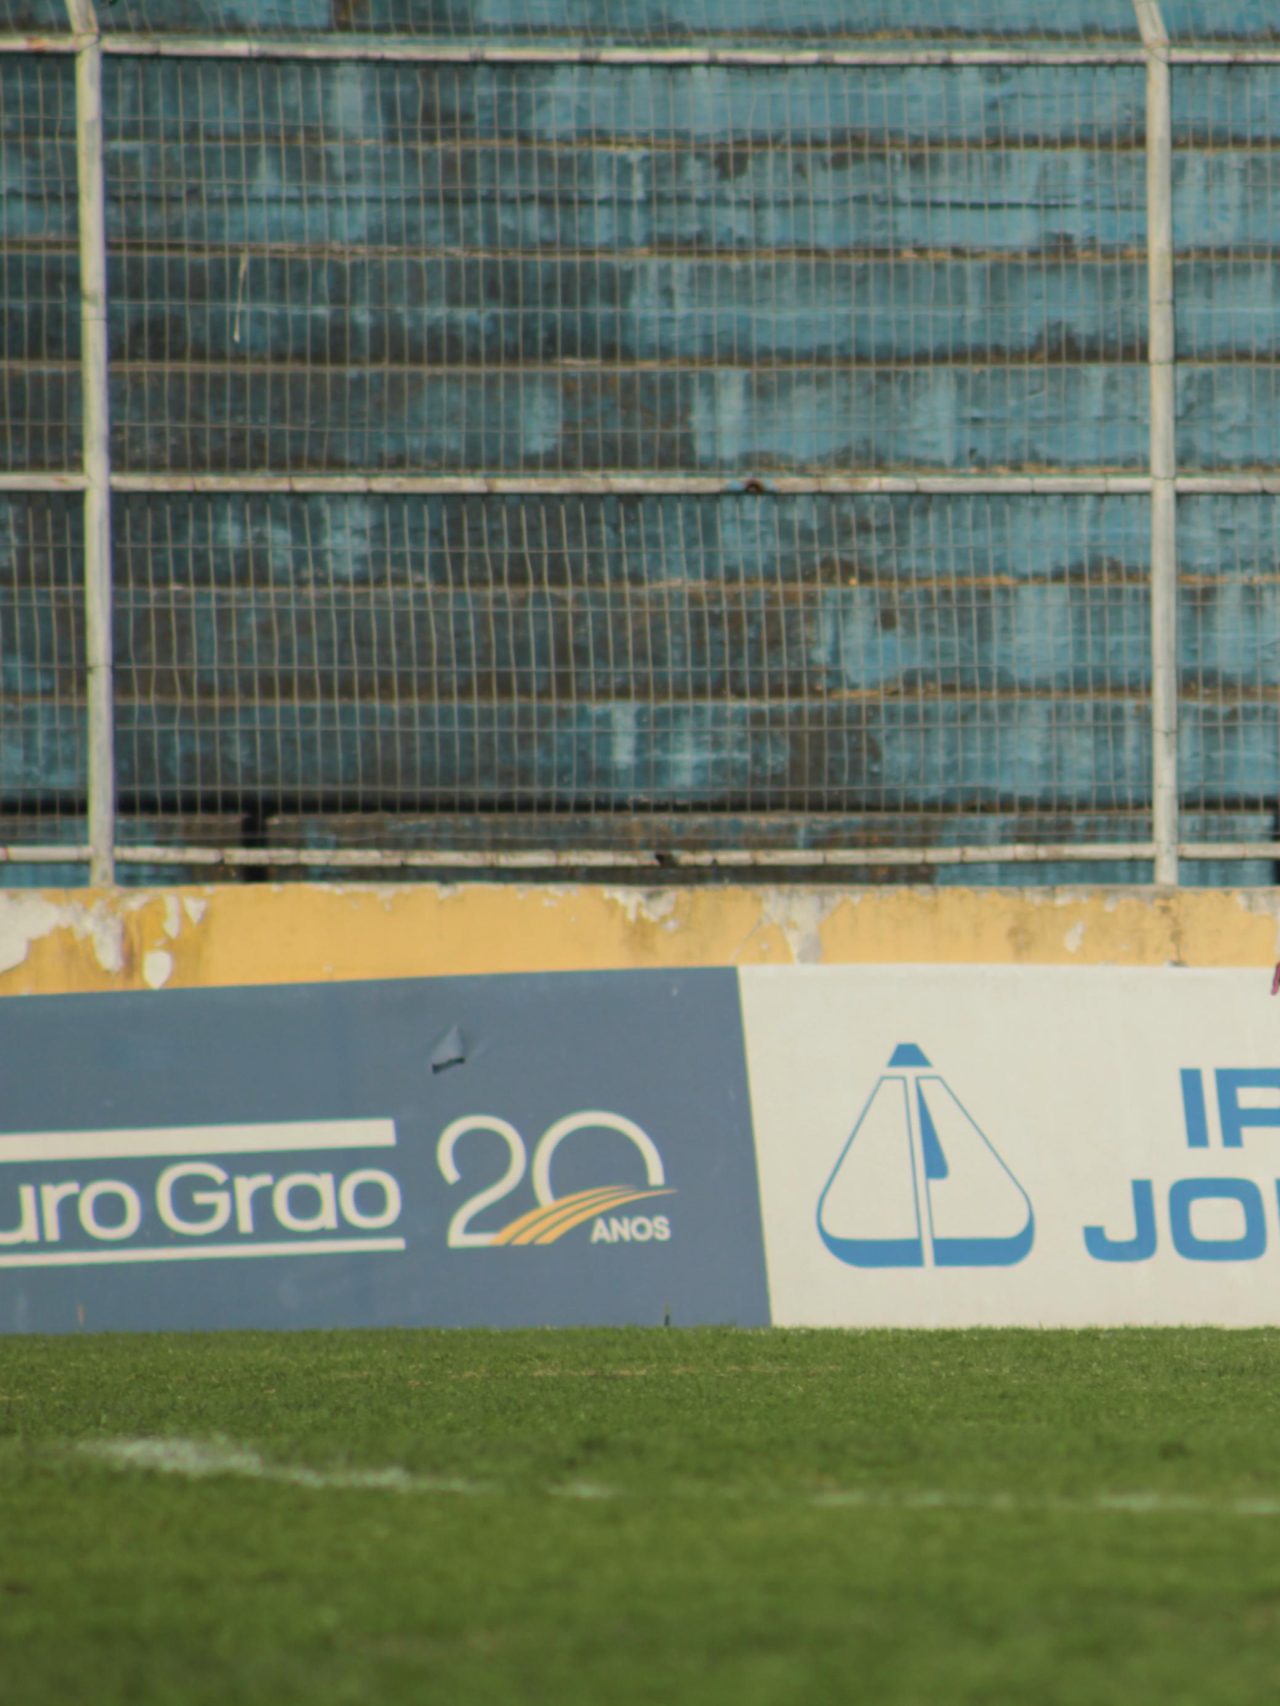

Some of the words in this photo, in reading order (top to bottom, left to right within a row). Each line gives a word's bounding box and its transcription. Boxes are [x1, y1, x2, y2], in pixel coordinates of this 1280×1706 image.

[156, 1161, 401, 1236] Grao
[436, 1110, 665, 1248] 20
[590, 1214, 672, 1244] ANOS
